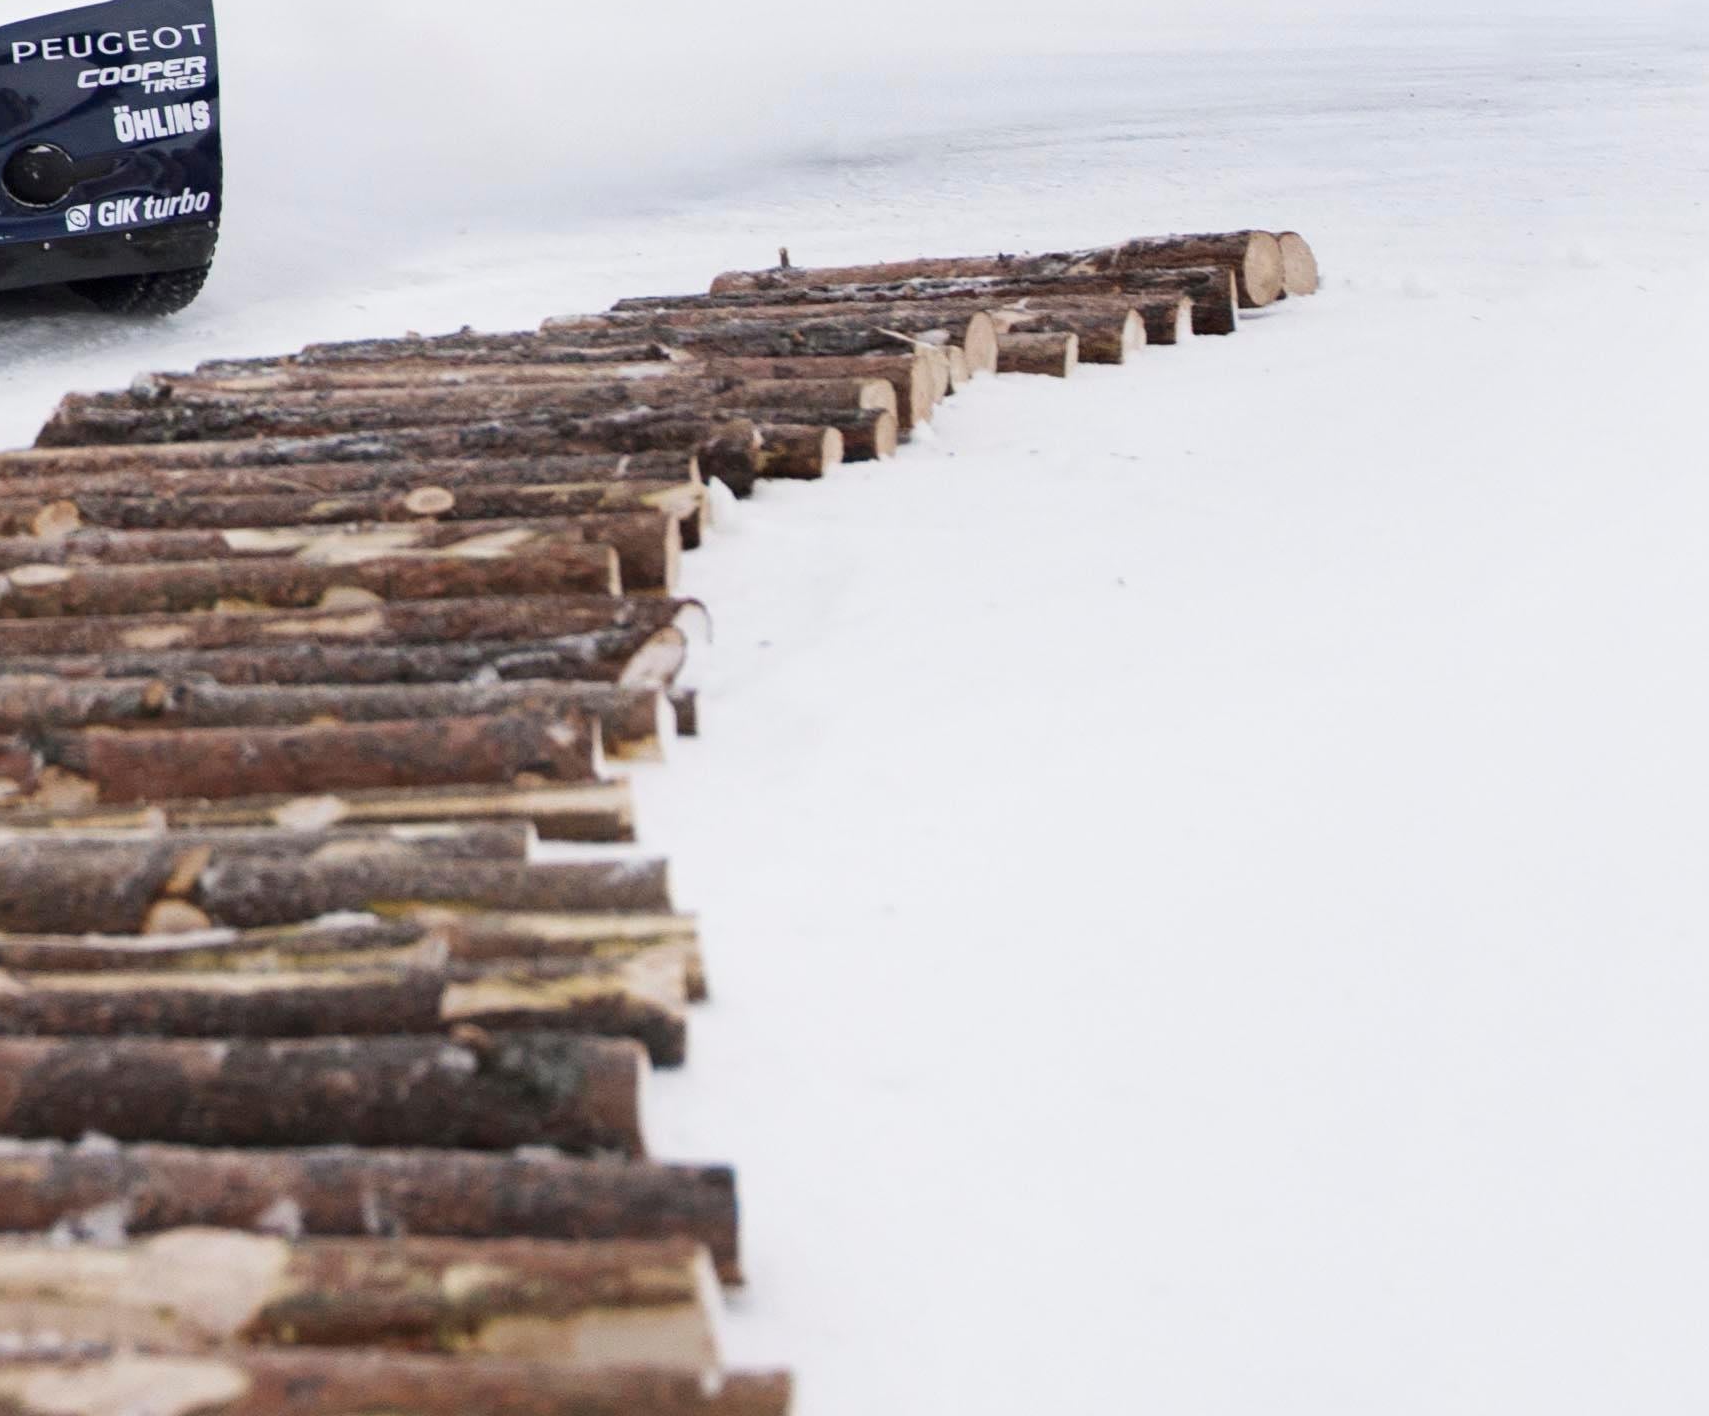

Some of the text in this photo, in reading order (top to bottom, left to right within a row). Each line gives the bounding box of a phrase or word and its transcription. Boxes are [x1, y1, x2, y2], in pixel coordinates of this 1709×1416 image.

[11, 23, 206, 64] PEUGEOT
[77, 56, 207, 88] COOPER
[141, 74, 206, 94] TIRES
[114, 100, 211, 143] ÖHLINS
[97, 187, 211, 227] GIK turbo
